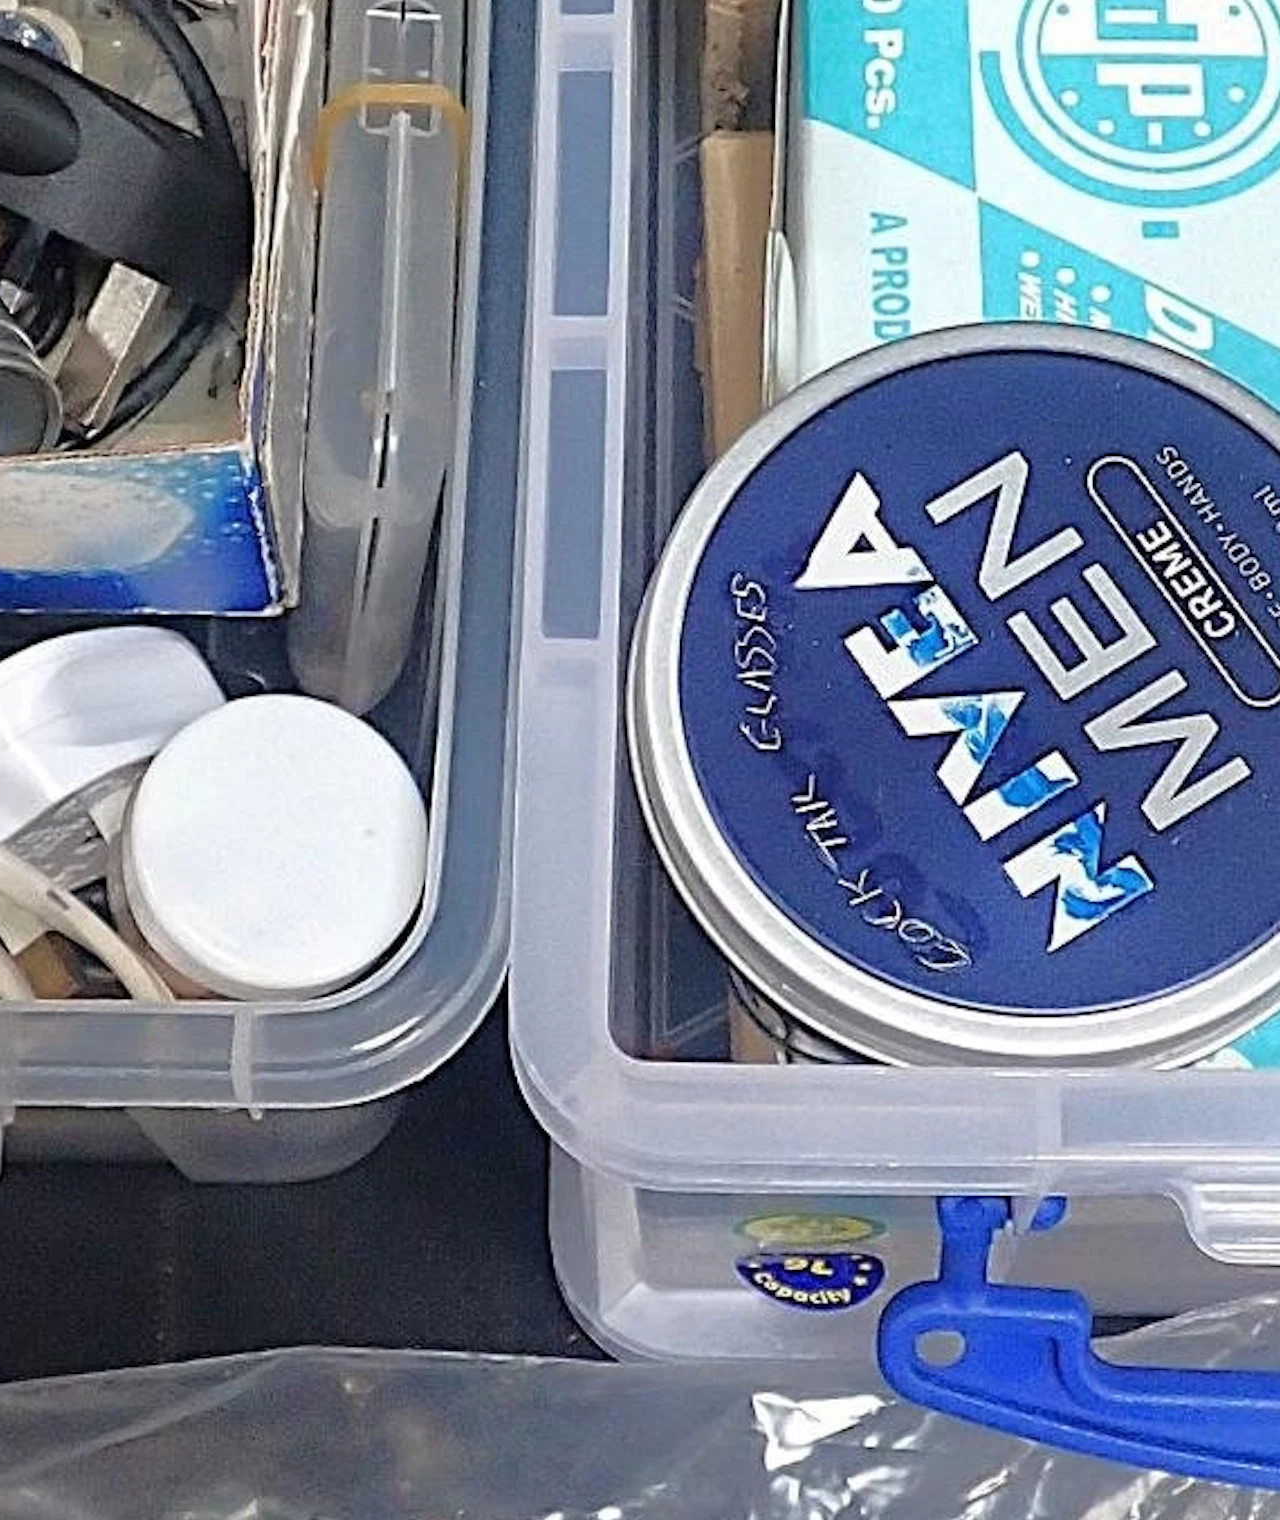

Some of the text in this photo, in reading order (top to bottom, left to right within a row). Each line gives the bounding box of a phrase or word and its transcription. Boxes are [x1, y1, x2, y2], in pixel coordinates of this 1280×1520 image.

[870, 211, 909, 235] A
[925, 449, 1252, 836] MEN
[1136, 521, 1236, 639] CREME
[794, 471, 1155, 954] NIVEA
